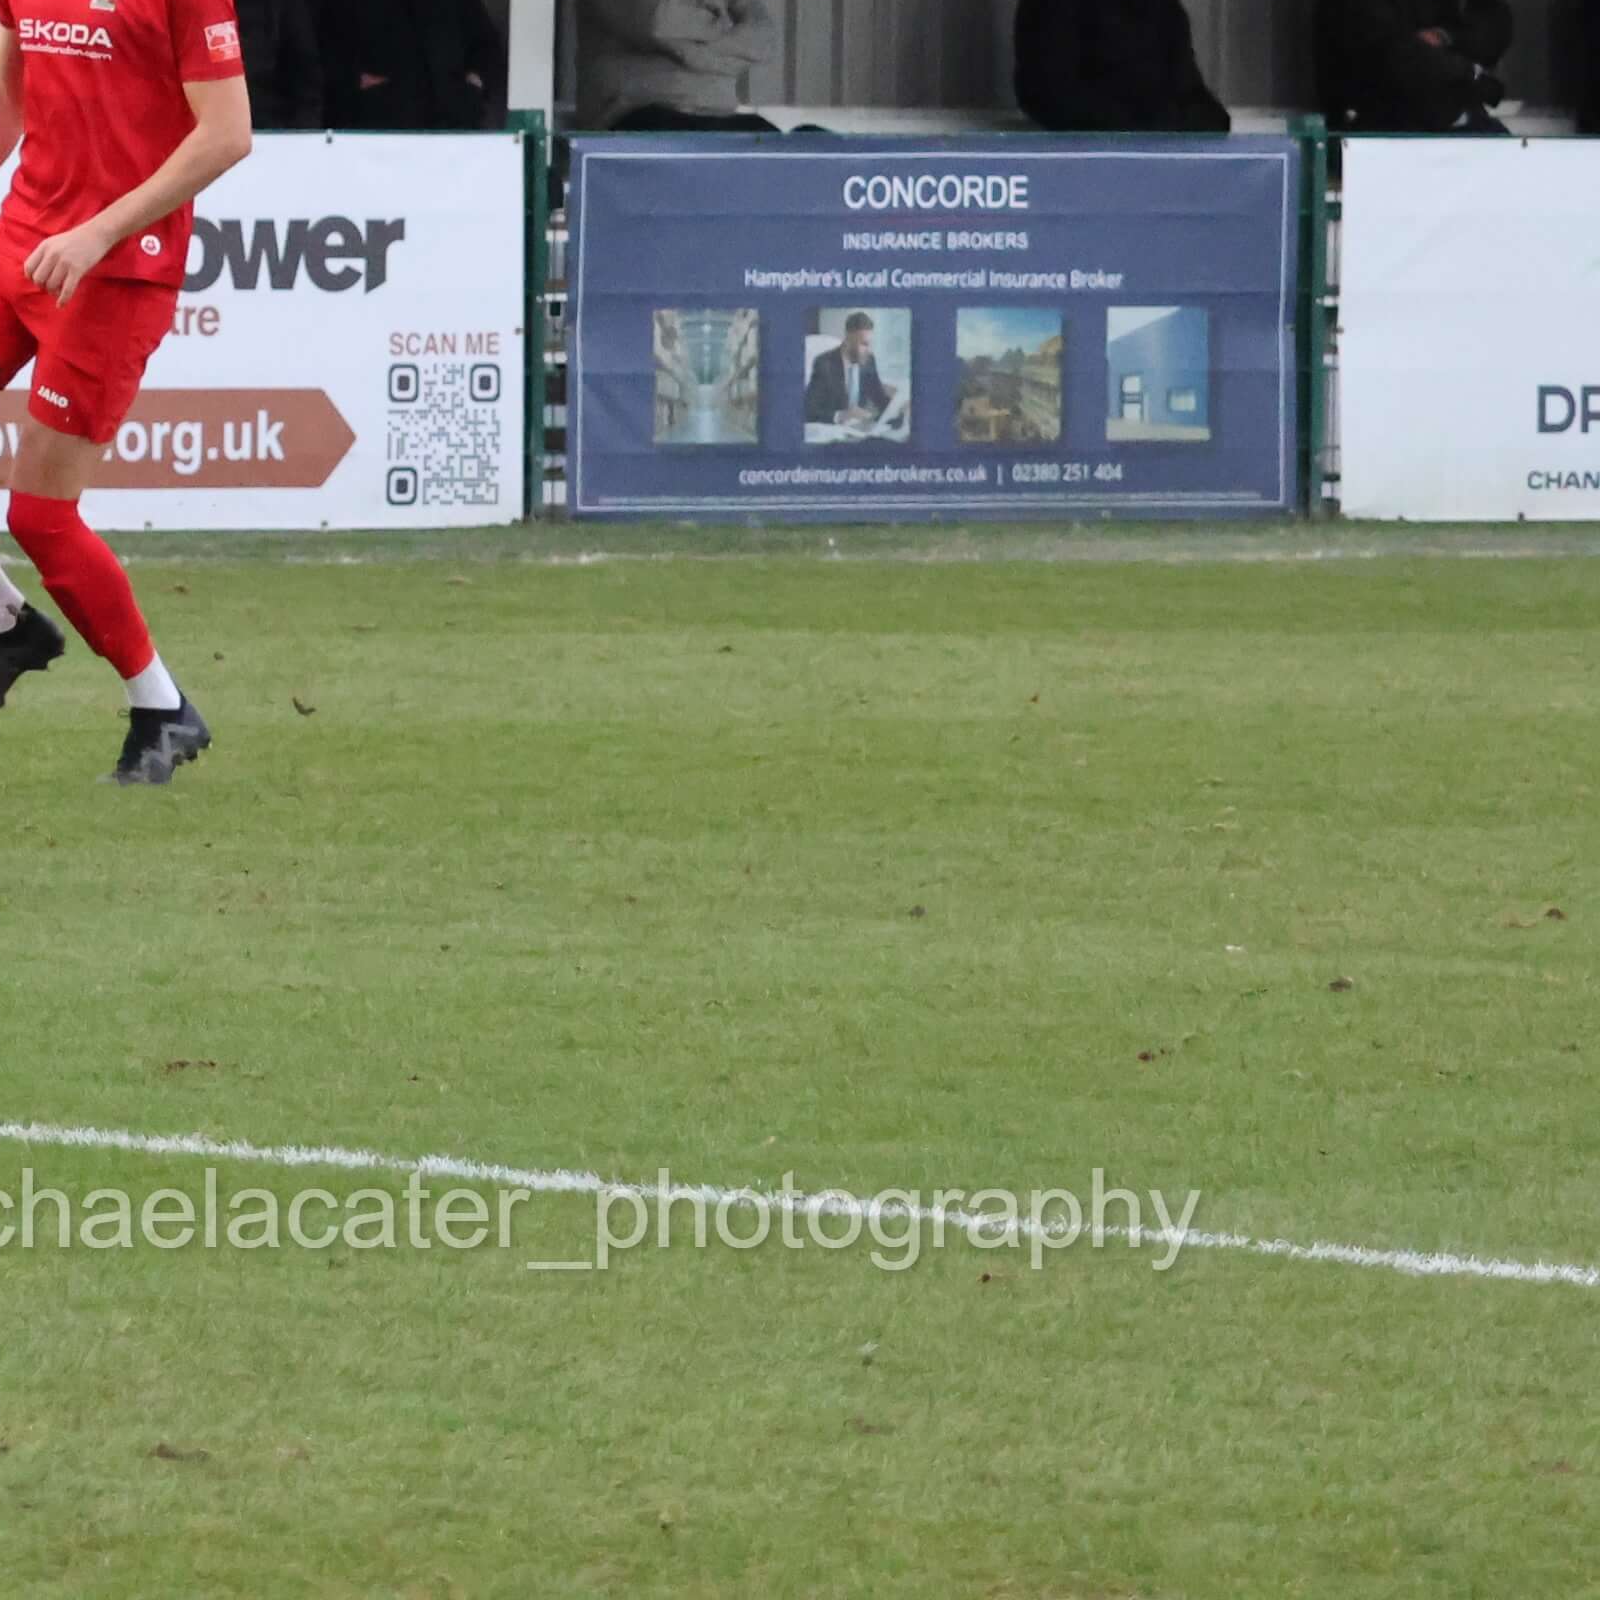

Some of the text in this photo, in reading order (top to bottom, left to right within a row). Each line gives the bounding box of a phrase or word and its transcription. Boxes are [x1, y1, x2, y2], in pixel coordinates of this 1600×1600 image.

[18, 18, 113, 48] SKODA
[842, 175, 1029, 209] CONCORDE
[843, 232, 1029, 250] INSURANCE BROKERS
[744, 268, 1123, 291] Hampshire's Local Commercial Insurance Broker
[388, 332, 501, 358] SCAN ME
[38, 384, 70, 409] JAKO
